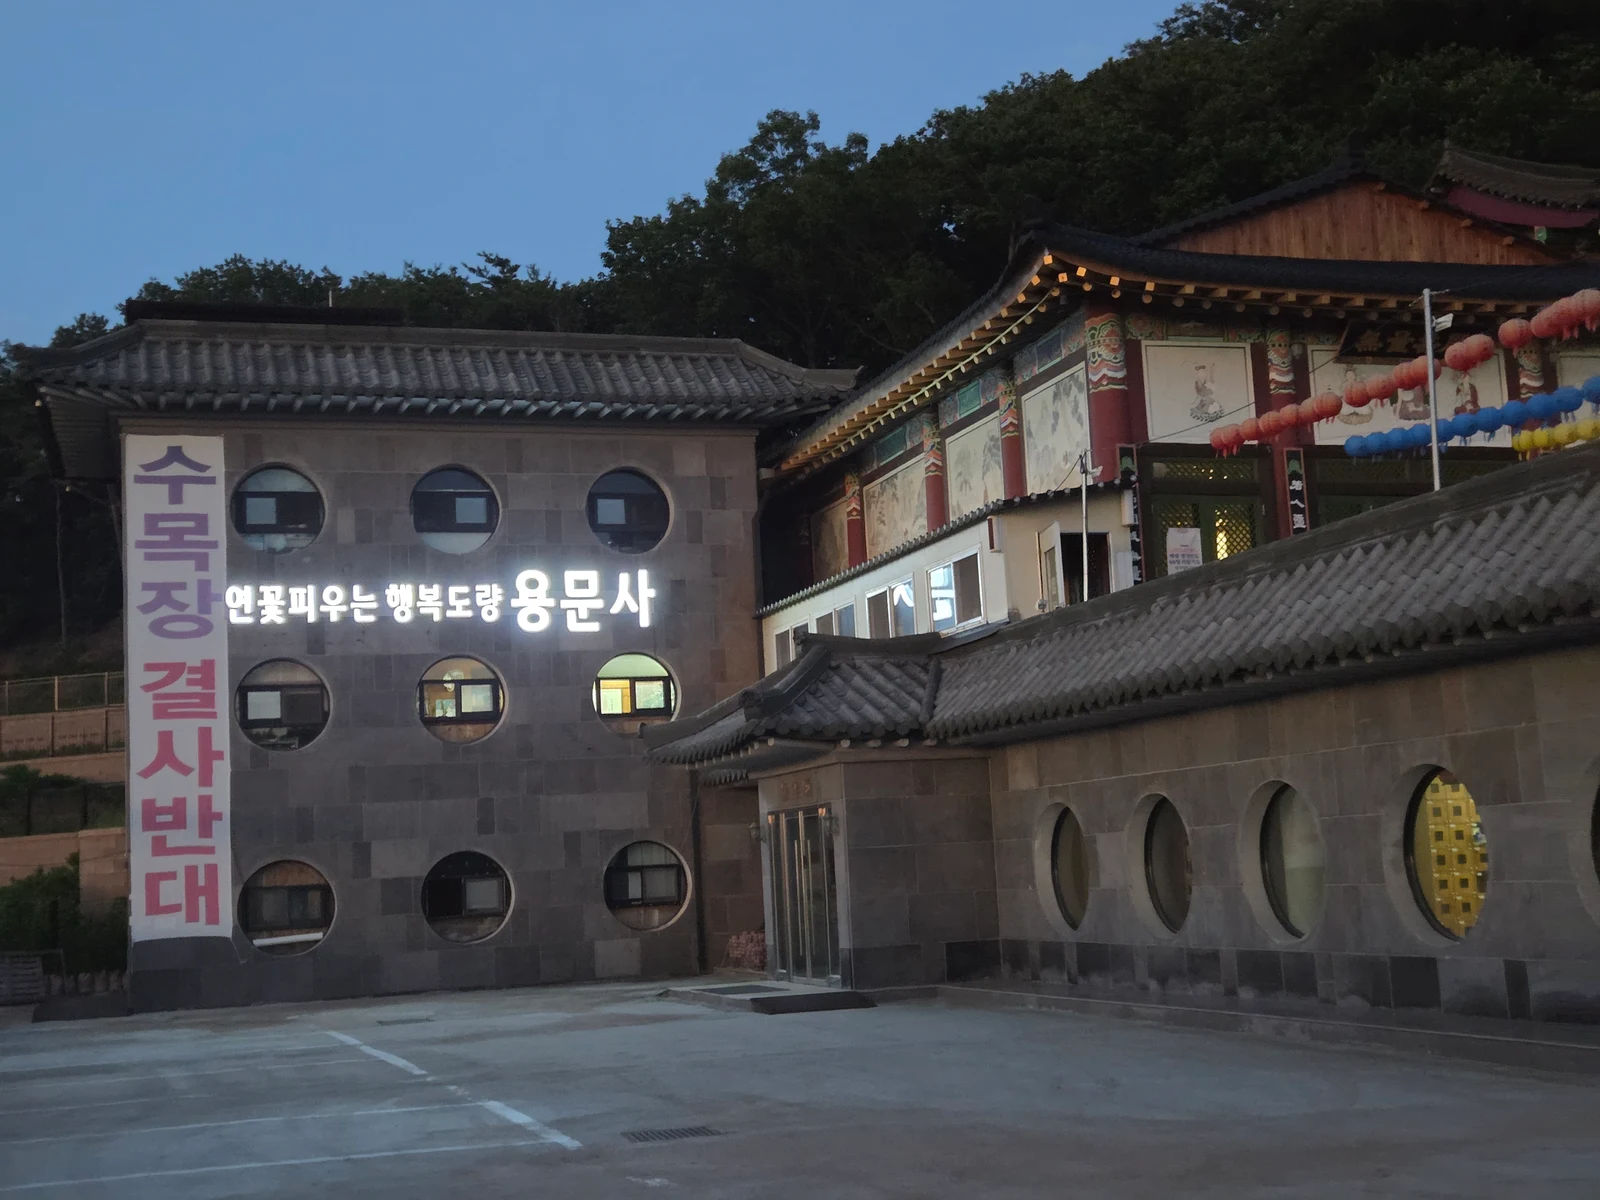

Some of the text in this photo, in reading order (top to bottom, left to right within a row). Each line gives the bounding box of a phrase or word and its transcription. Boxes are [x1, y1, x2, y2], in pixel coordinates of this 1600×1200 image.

[134, 446, 224, 925] 수목장 결사반대
[225, 568, 657, 632] 연꽃피우는 행복도량 용문사
